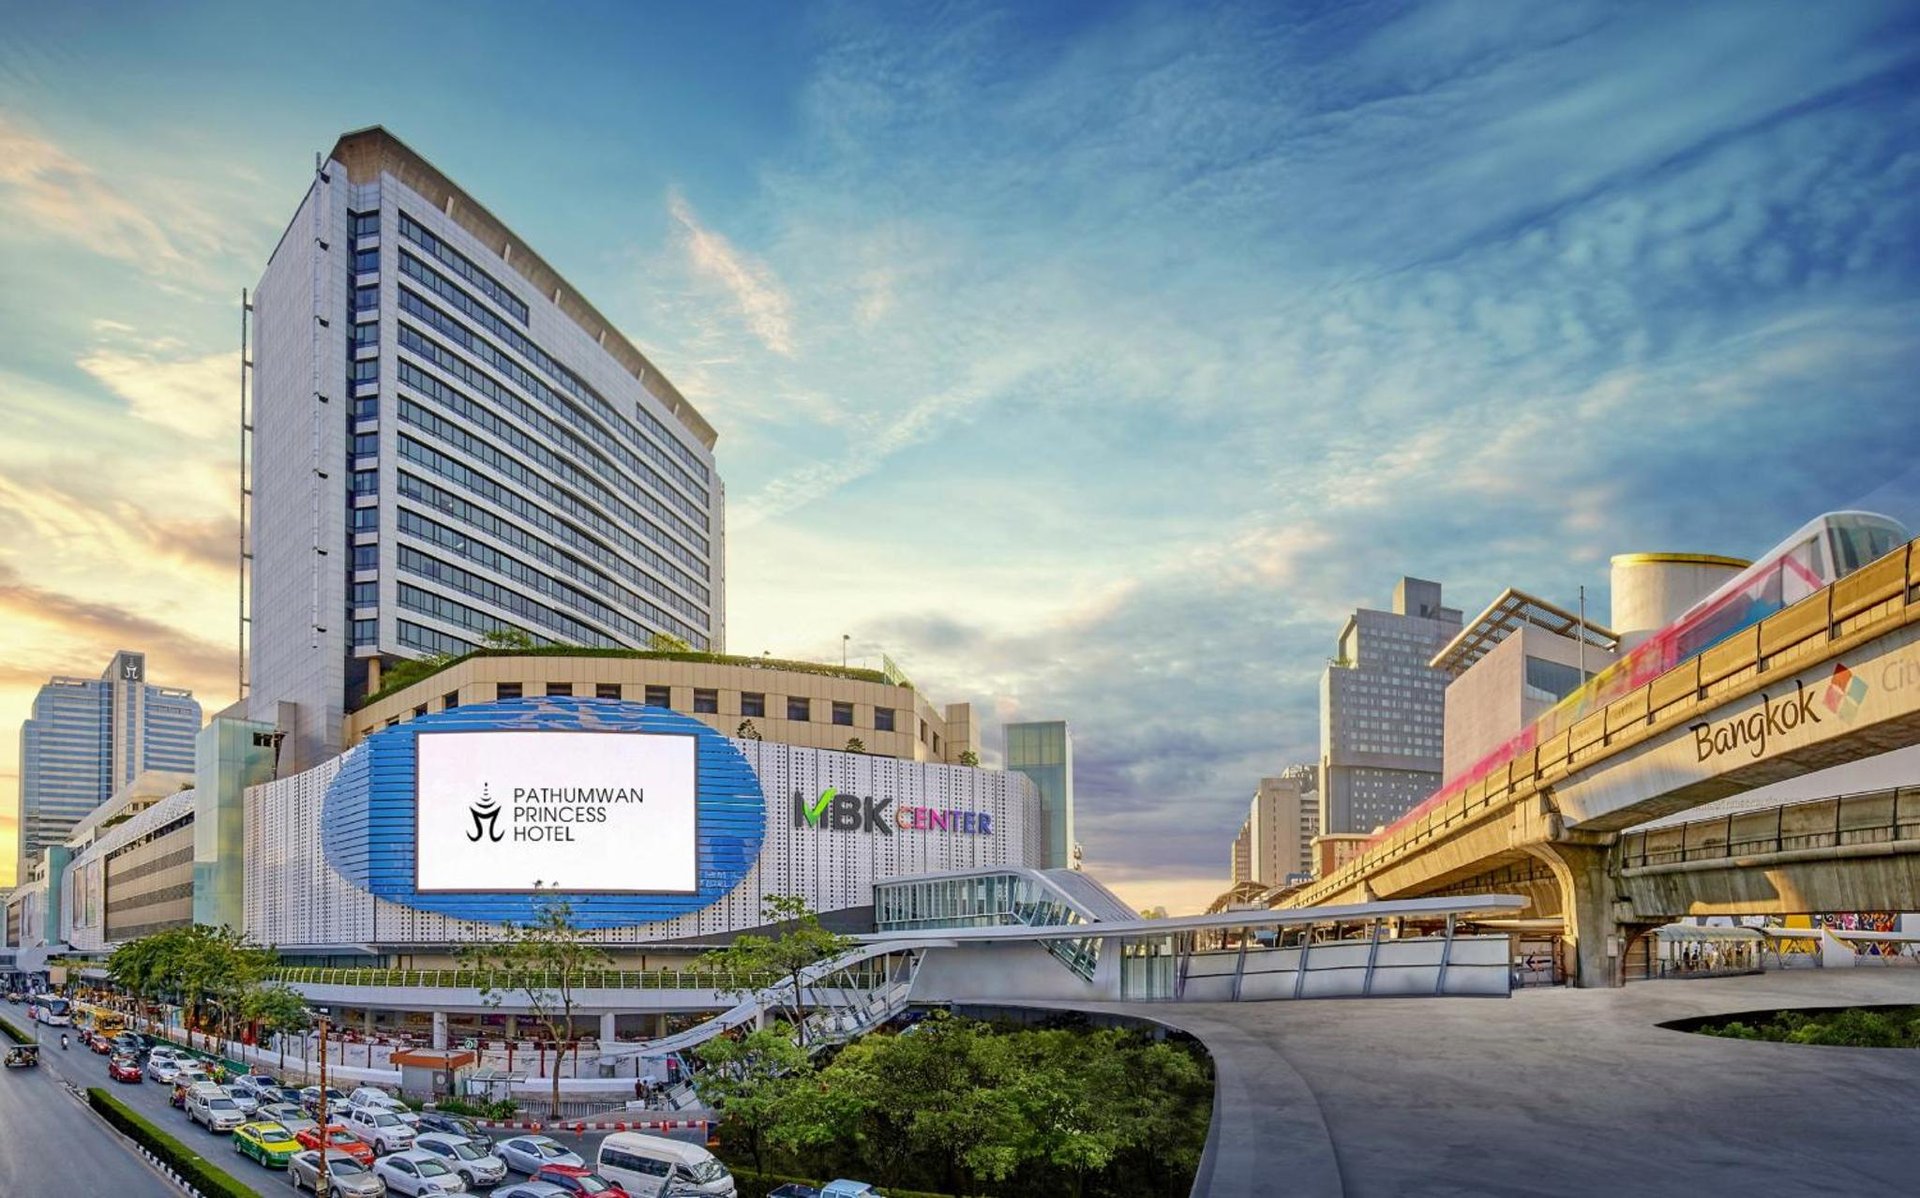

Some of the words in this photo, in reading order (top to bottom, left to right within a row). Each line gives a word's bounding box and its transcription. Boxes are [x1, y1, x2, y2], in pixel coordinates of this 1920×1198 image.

[1689, 680, 1821, 762] Bangkok
[513, 788, 643, 803] PATHUMWAN
[513, 807, 606, 822] PRINCESS
[794, 787, 893, 836] MBK
[895, 804, 992, 834] CENTER
[513, 826, 575, 841] HOTEL
